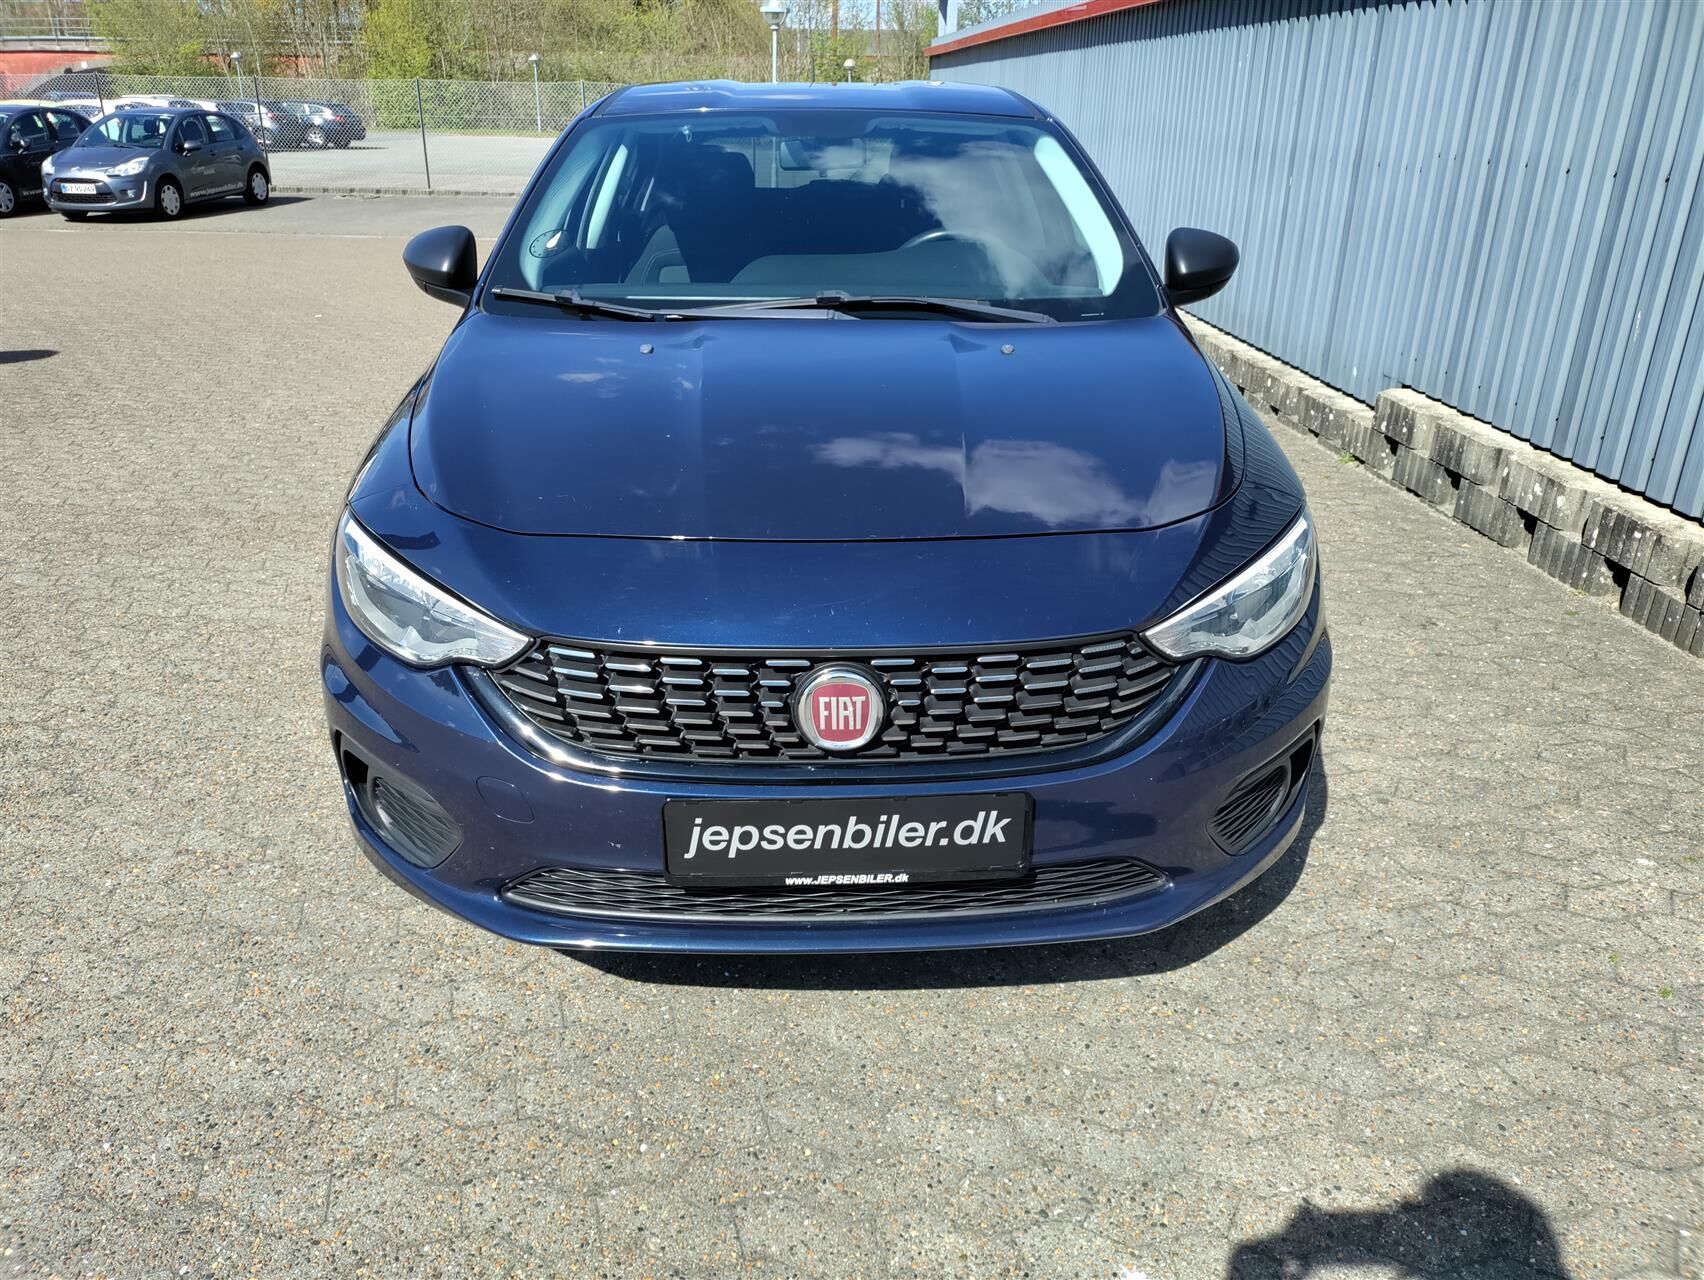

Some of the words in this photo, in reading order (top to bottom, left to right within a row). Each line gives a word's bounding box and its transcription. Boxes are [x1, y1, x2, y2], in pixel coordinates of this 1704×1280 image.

[818, 695, 866, 731] FIAT
[683, 810, 1012, 859] jepsenbiler.dk
[785, 873, 909, 886] www.JEPSENBILER.dk
